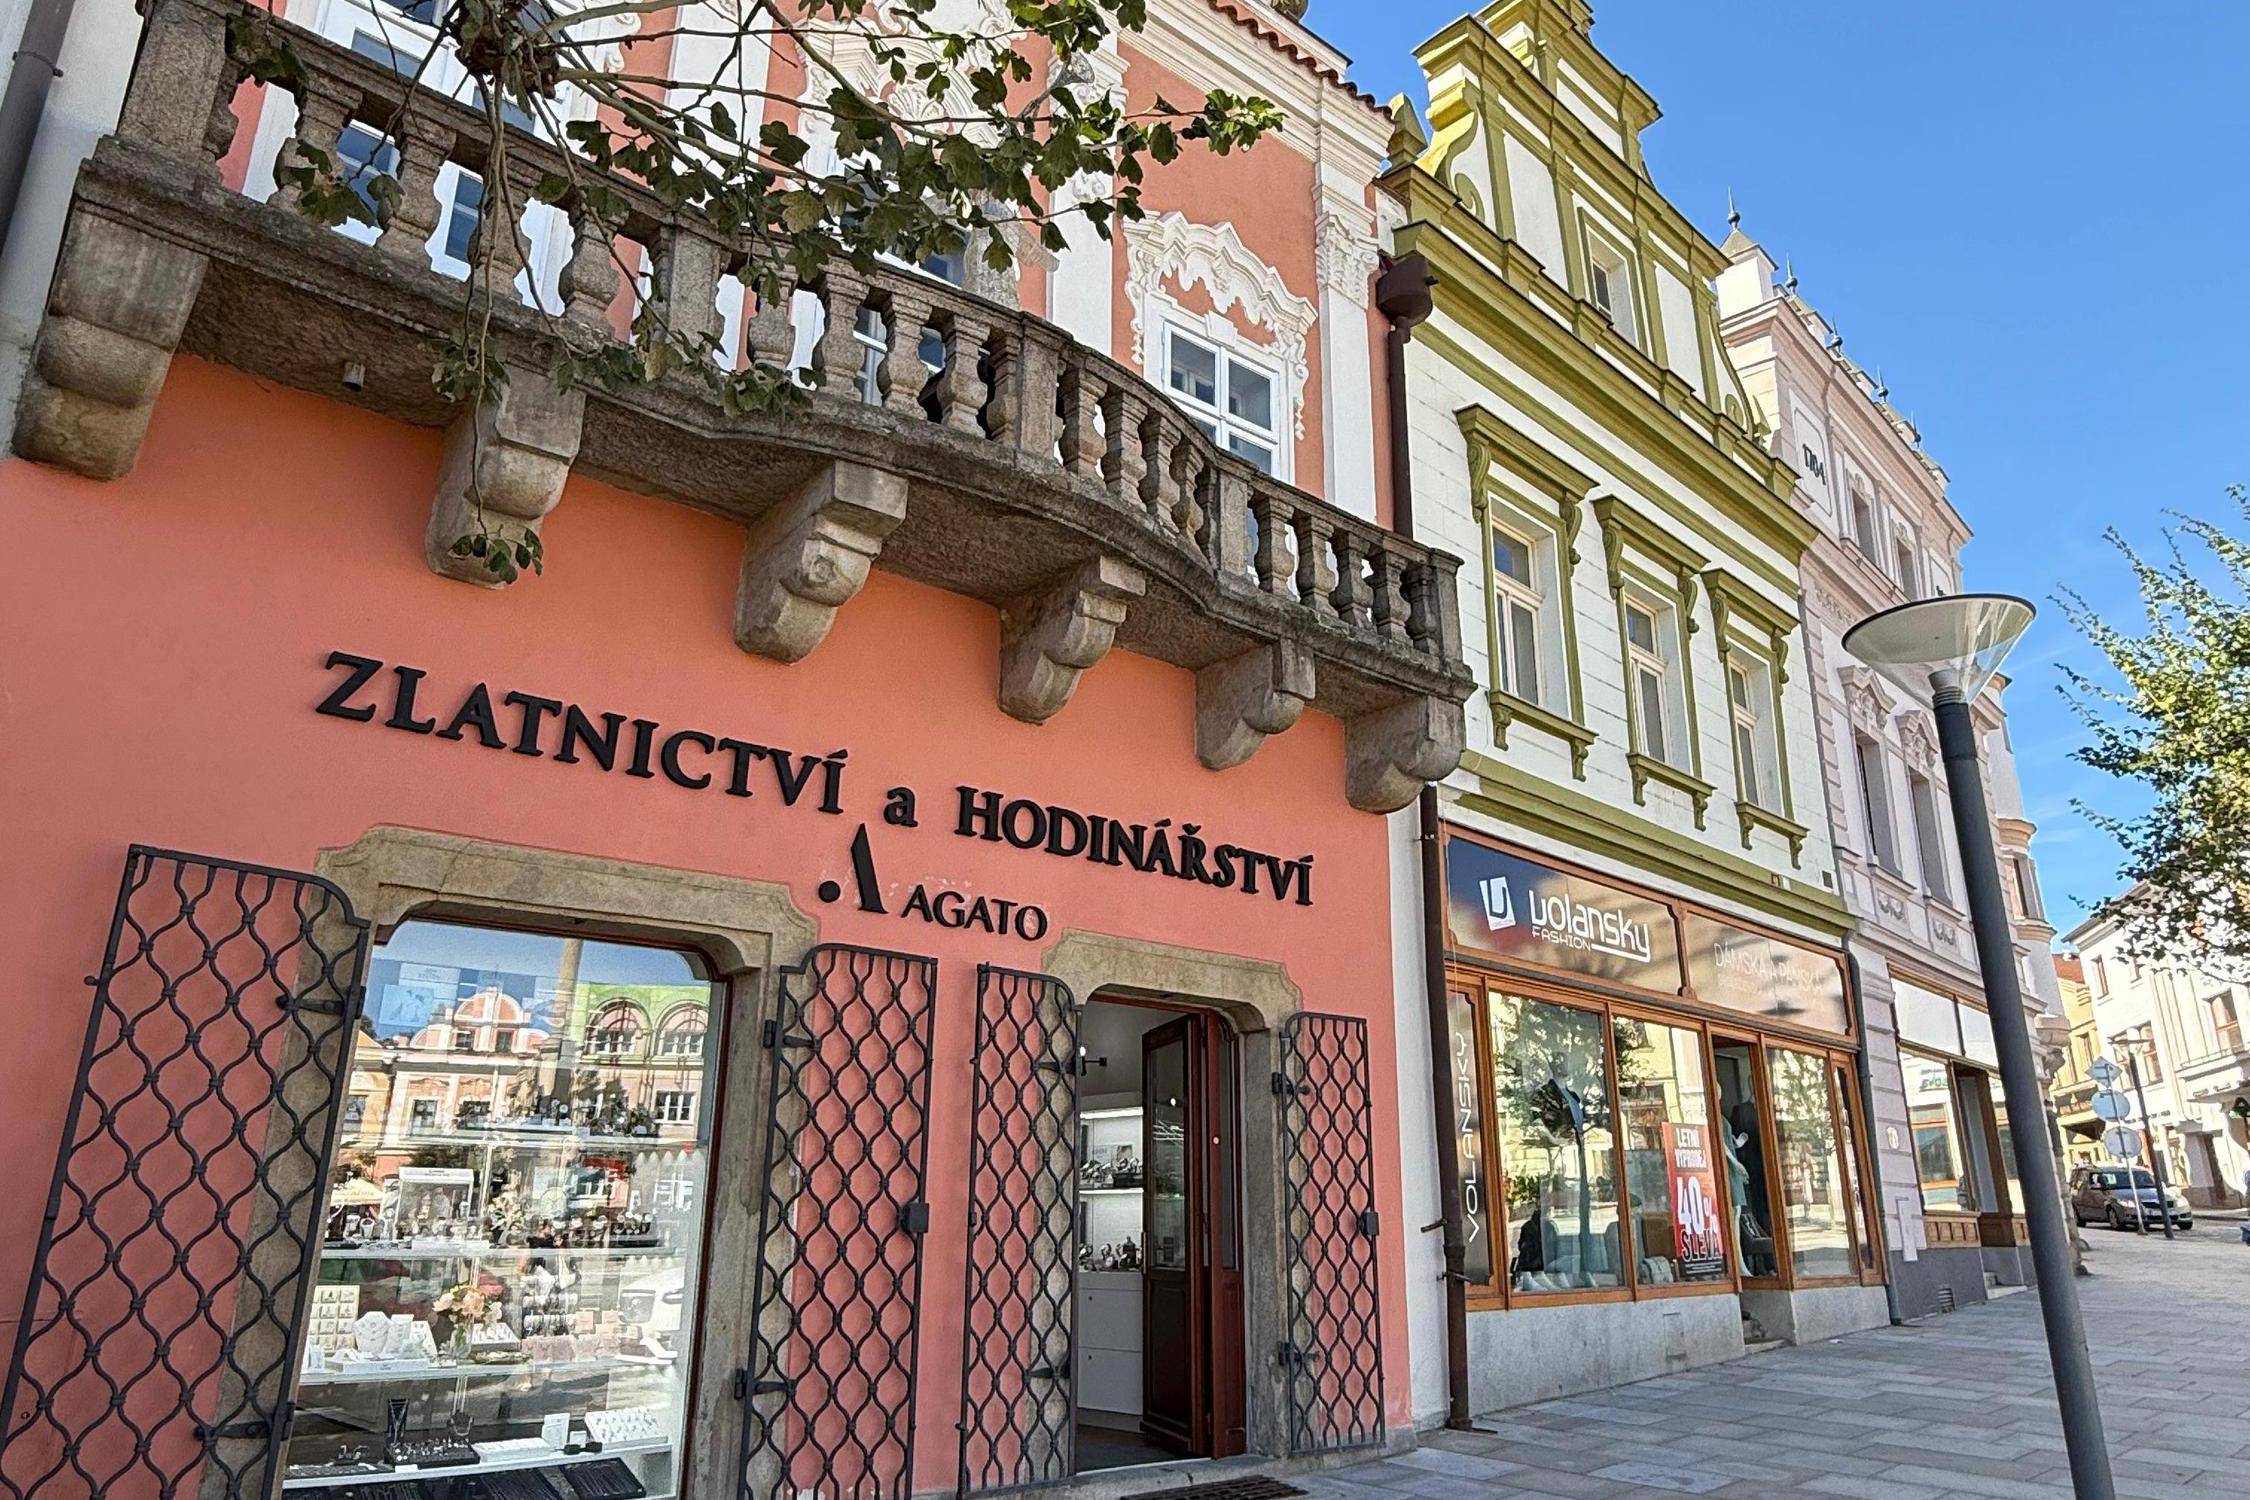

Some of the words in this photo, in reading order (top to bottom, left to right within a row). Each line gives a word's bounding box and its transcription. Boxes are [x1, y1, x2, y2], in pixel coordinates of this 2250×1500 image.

[1802, 443, 1826, 486] 1704
[315, 651, 847, 814] ZLATNICTVÍ
[883, 787, 917, 827] a
[954, 785, 1314, 906] HODINÁŘSTVÍ
[901, 884, 1047, 941] AGATO
[1532, 925, 1591, 951] FASHION
[1455, 1031, 1480, 1243] VOLANSKY
[1681, 1228, 1723, 1262] SLEVA
